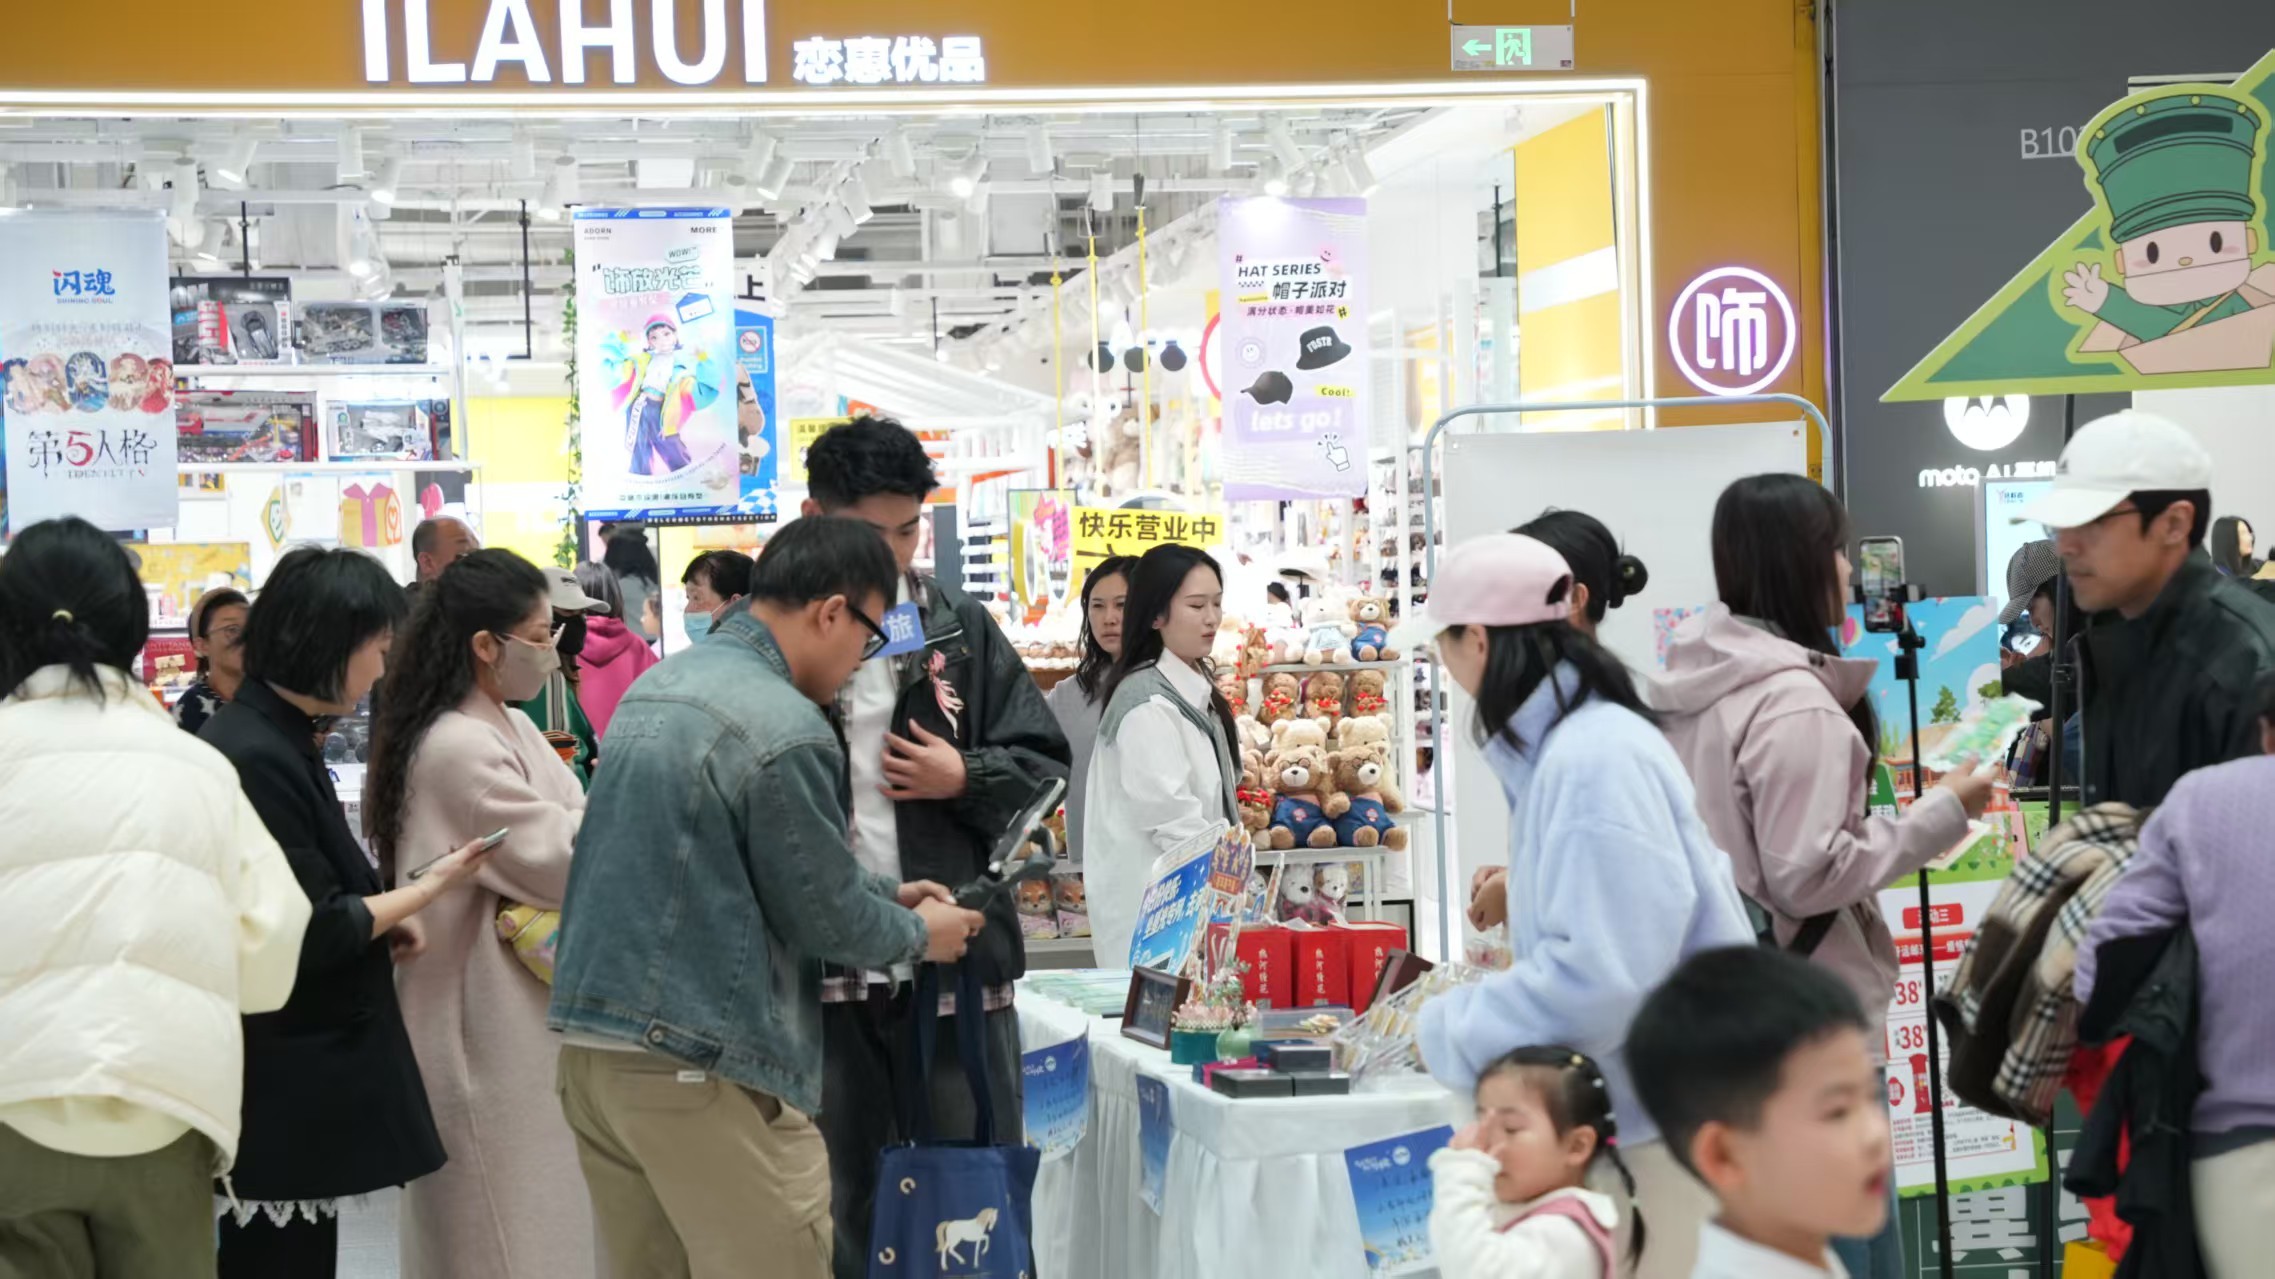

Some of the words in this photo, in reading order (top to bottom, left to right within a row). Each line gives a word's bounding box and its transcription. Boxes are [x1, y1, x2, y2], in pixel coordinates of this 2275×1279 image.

[362, 0, 768, 85] ILAHUI
[793, 36, 985, 85] 恋惠优品
[2020, 126, 2085, 158] B10
[690, 226, 718, 234] MORE
[53, 269, 116, 296] 闪魂
[1238, 265, 1268, 277] HAT
[1272, 263, 1321, 276] SERIES
[1272, 280, 1347, 300] 帽子派对
[1301, 406, 1343, 432] go!
[28, 429, 158, 477] 第5人格
[1919, 465, 1980, 487] moto
[1986, 463, 2010, 478] AI
[1079, 512, 1216, 543] 快乐营业中
[880, 614, 915, 643] 旅
[1900, 1025, 1924, 1049] 38
